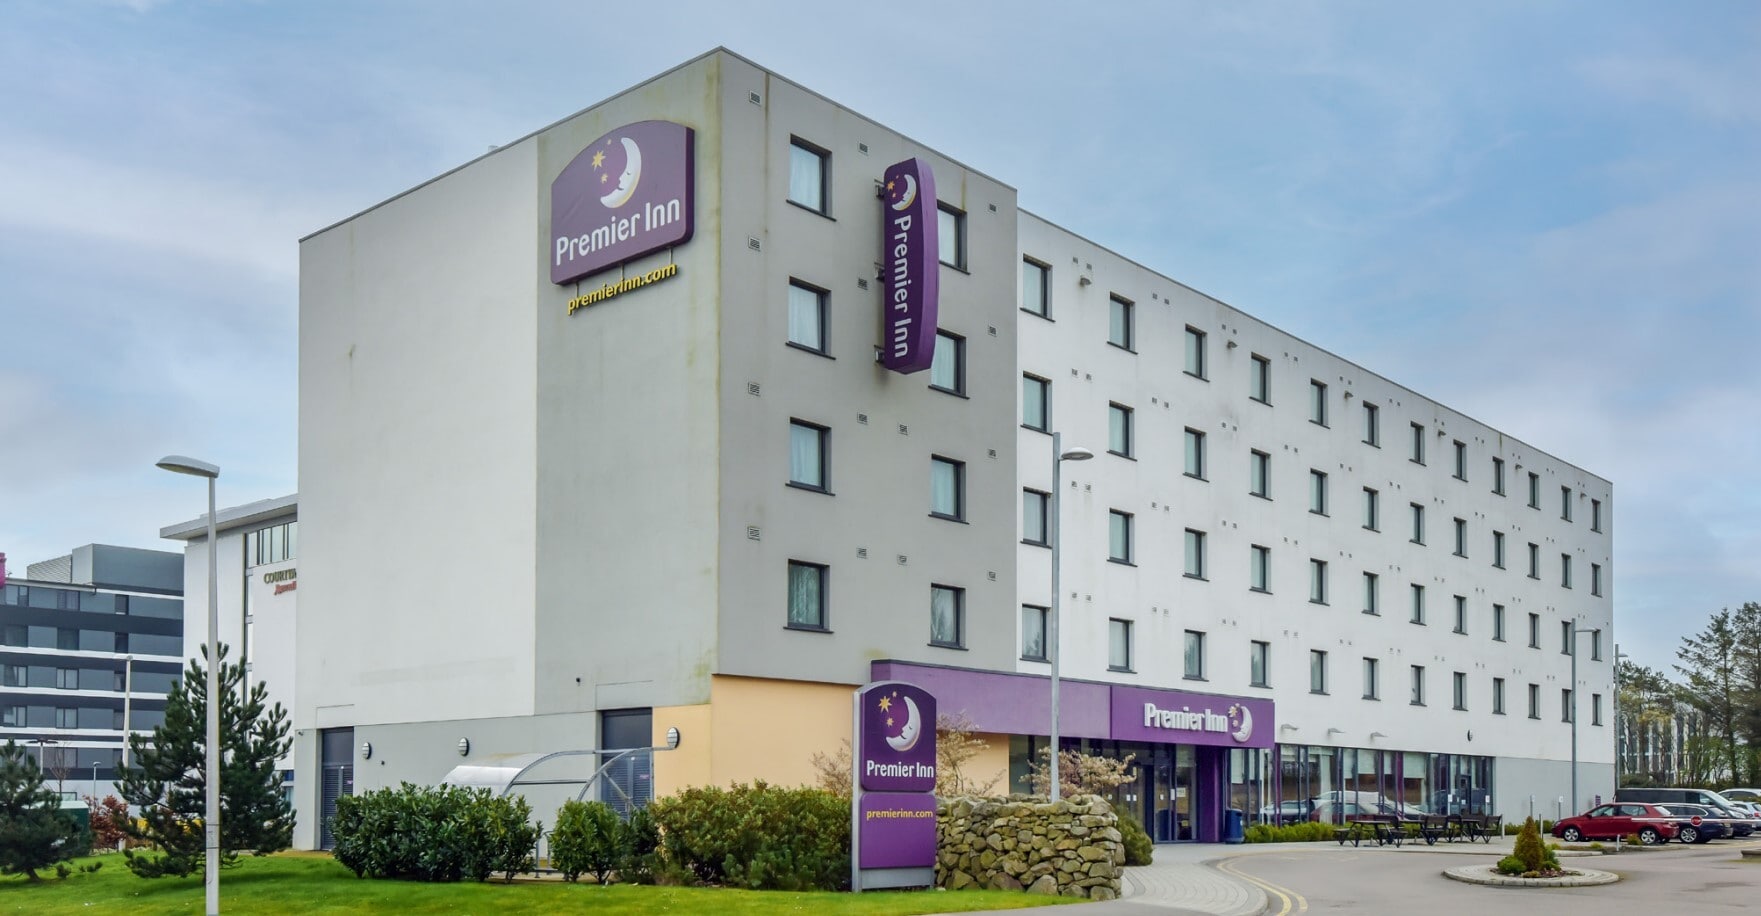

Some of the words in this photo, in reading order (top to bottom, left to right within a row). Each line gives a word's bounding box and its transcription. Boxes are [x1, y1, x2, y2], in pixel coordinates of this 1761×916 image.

[556, 213, 640, 266] Premier
[645, 199, 680, 232] Inn
[894, 215, 911, 313] Premier
[567, 263, 677, 316] premierinn.com
[894, 318, 911, 358] Inn
[1144, 702, 1204, 731] Premier
[1205, 708, 1228, 733] Inn
[867, 760, 914, 778] Premier
[916, 762, 934, 778] Inn
[866, 808, 933, 821] premierinn.com
